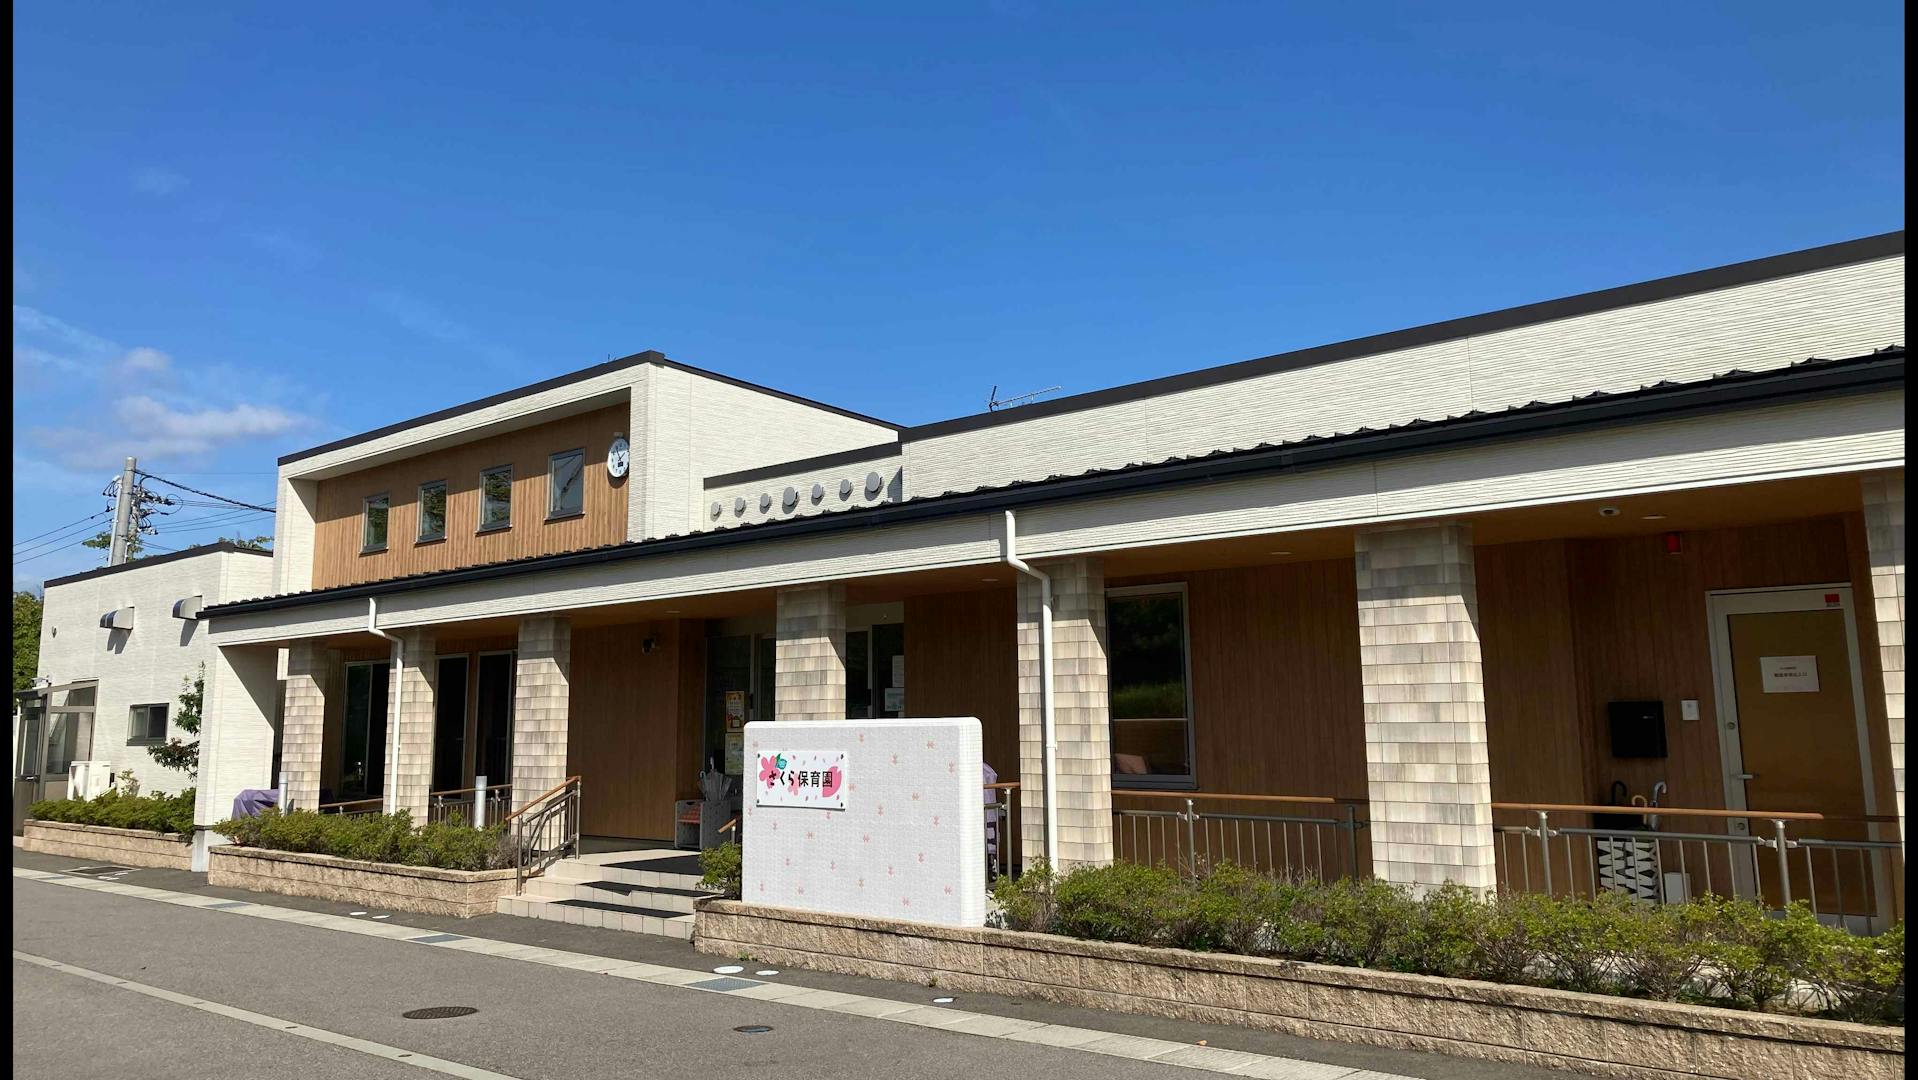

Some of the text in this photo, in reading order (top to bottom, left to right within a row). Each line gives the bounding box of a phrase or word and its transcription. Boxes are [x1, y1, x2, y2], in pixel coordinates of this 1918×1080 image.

[769, 771, 833, 788] さくら保育園
